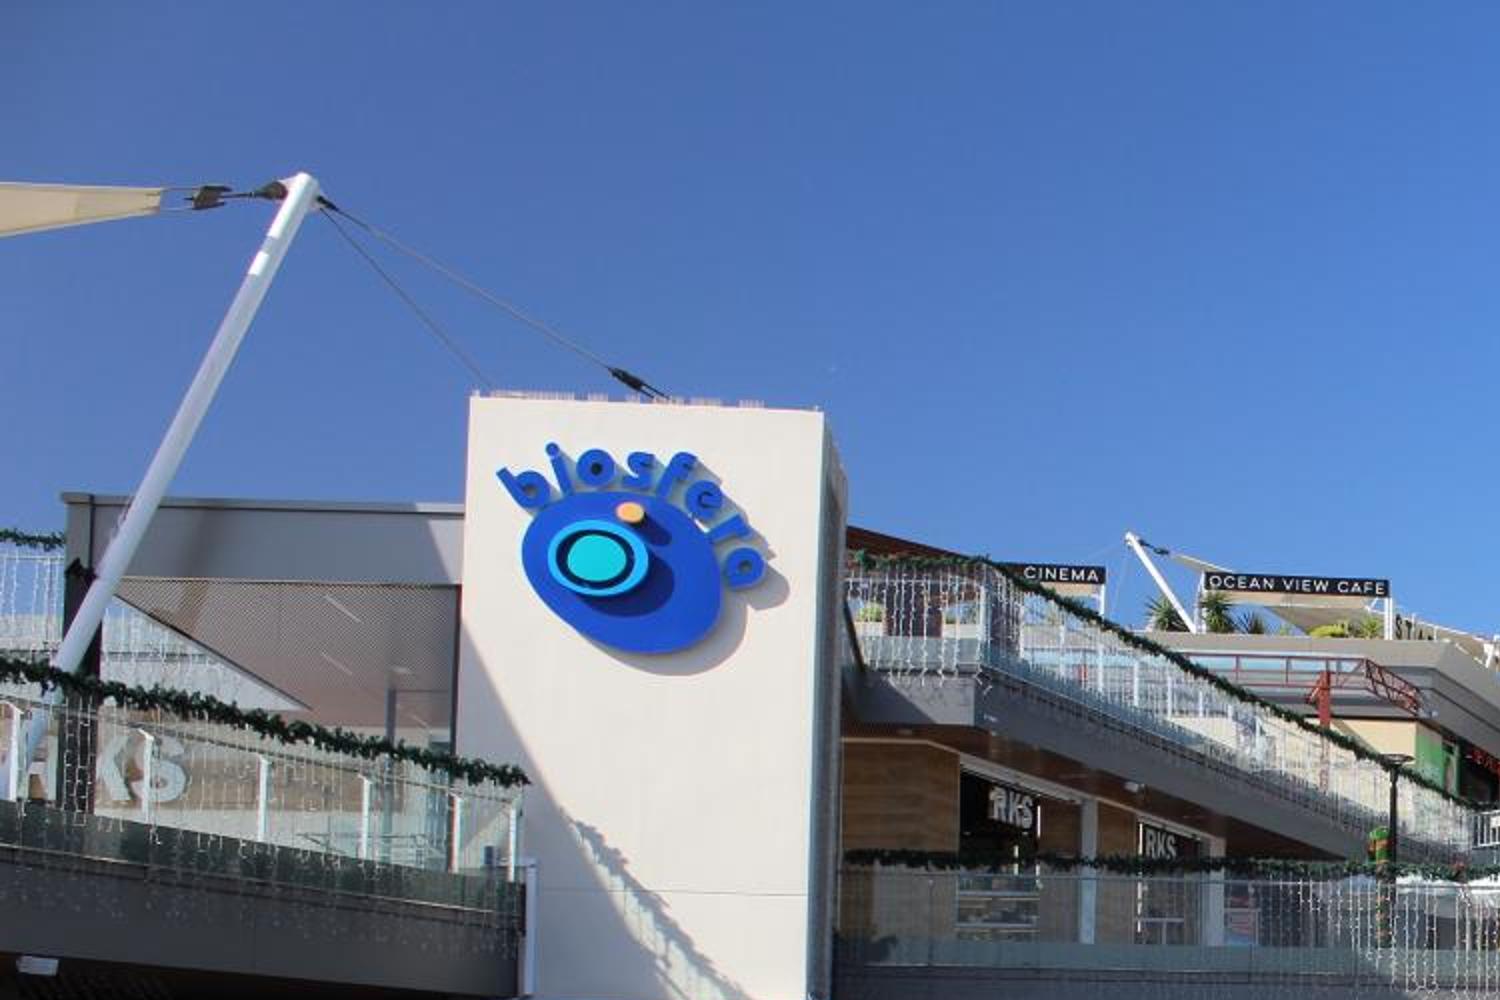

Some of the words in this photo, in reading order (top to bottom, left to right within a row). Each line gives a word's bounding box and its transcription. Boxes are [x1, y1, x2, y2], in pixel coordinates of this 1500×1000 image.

[496, 442, 765, 589] biosfera
[1023, 566, 1100, 582] CINEMA
[1208, 574, 1275, 591] OCEAN
[1282, 577, 1330, 593] VIEW
[1336, 580, 1386, 596] CAFE
